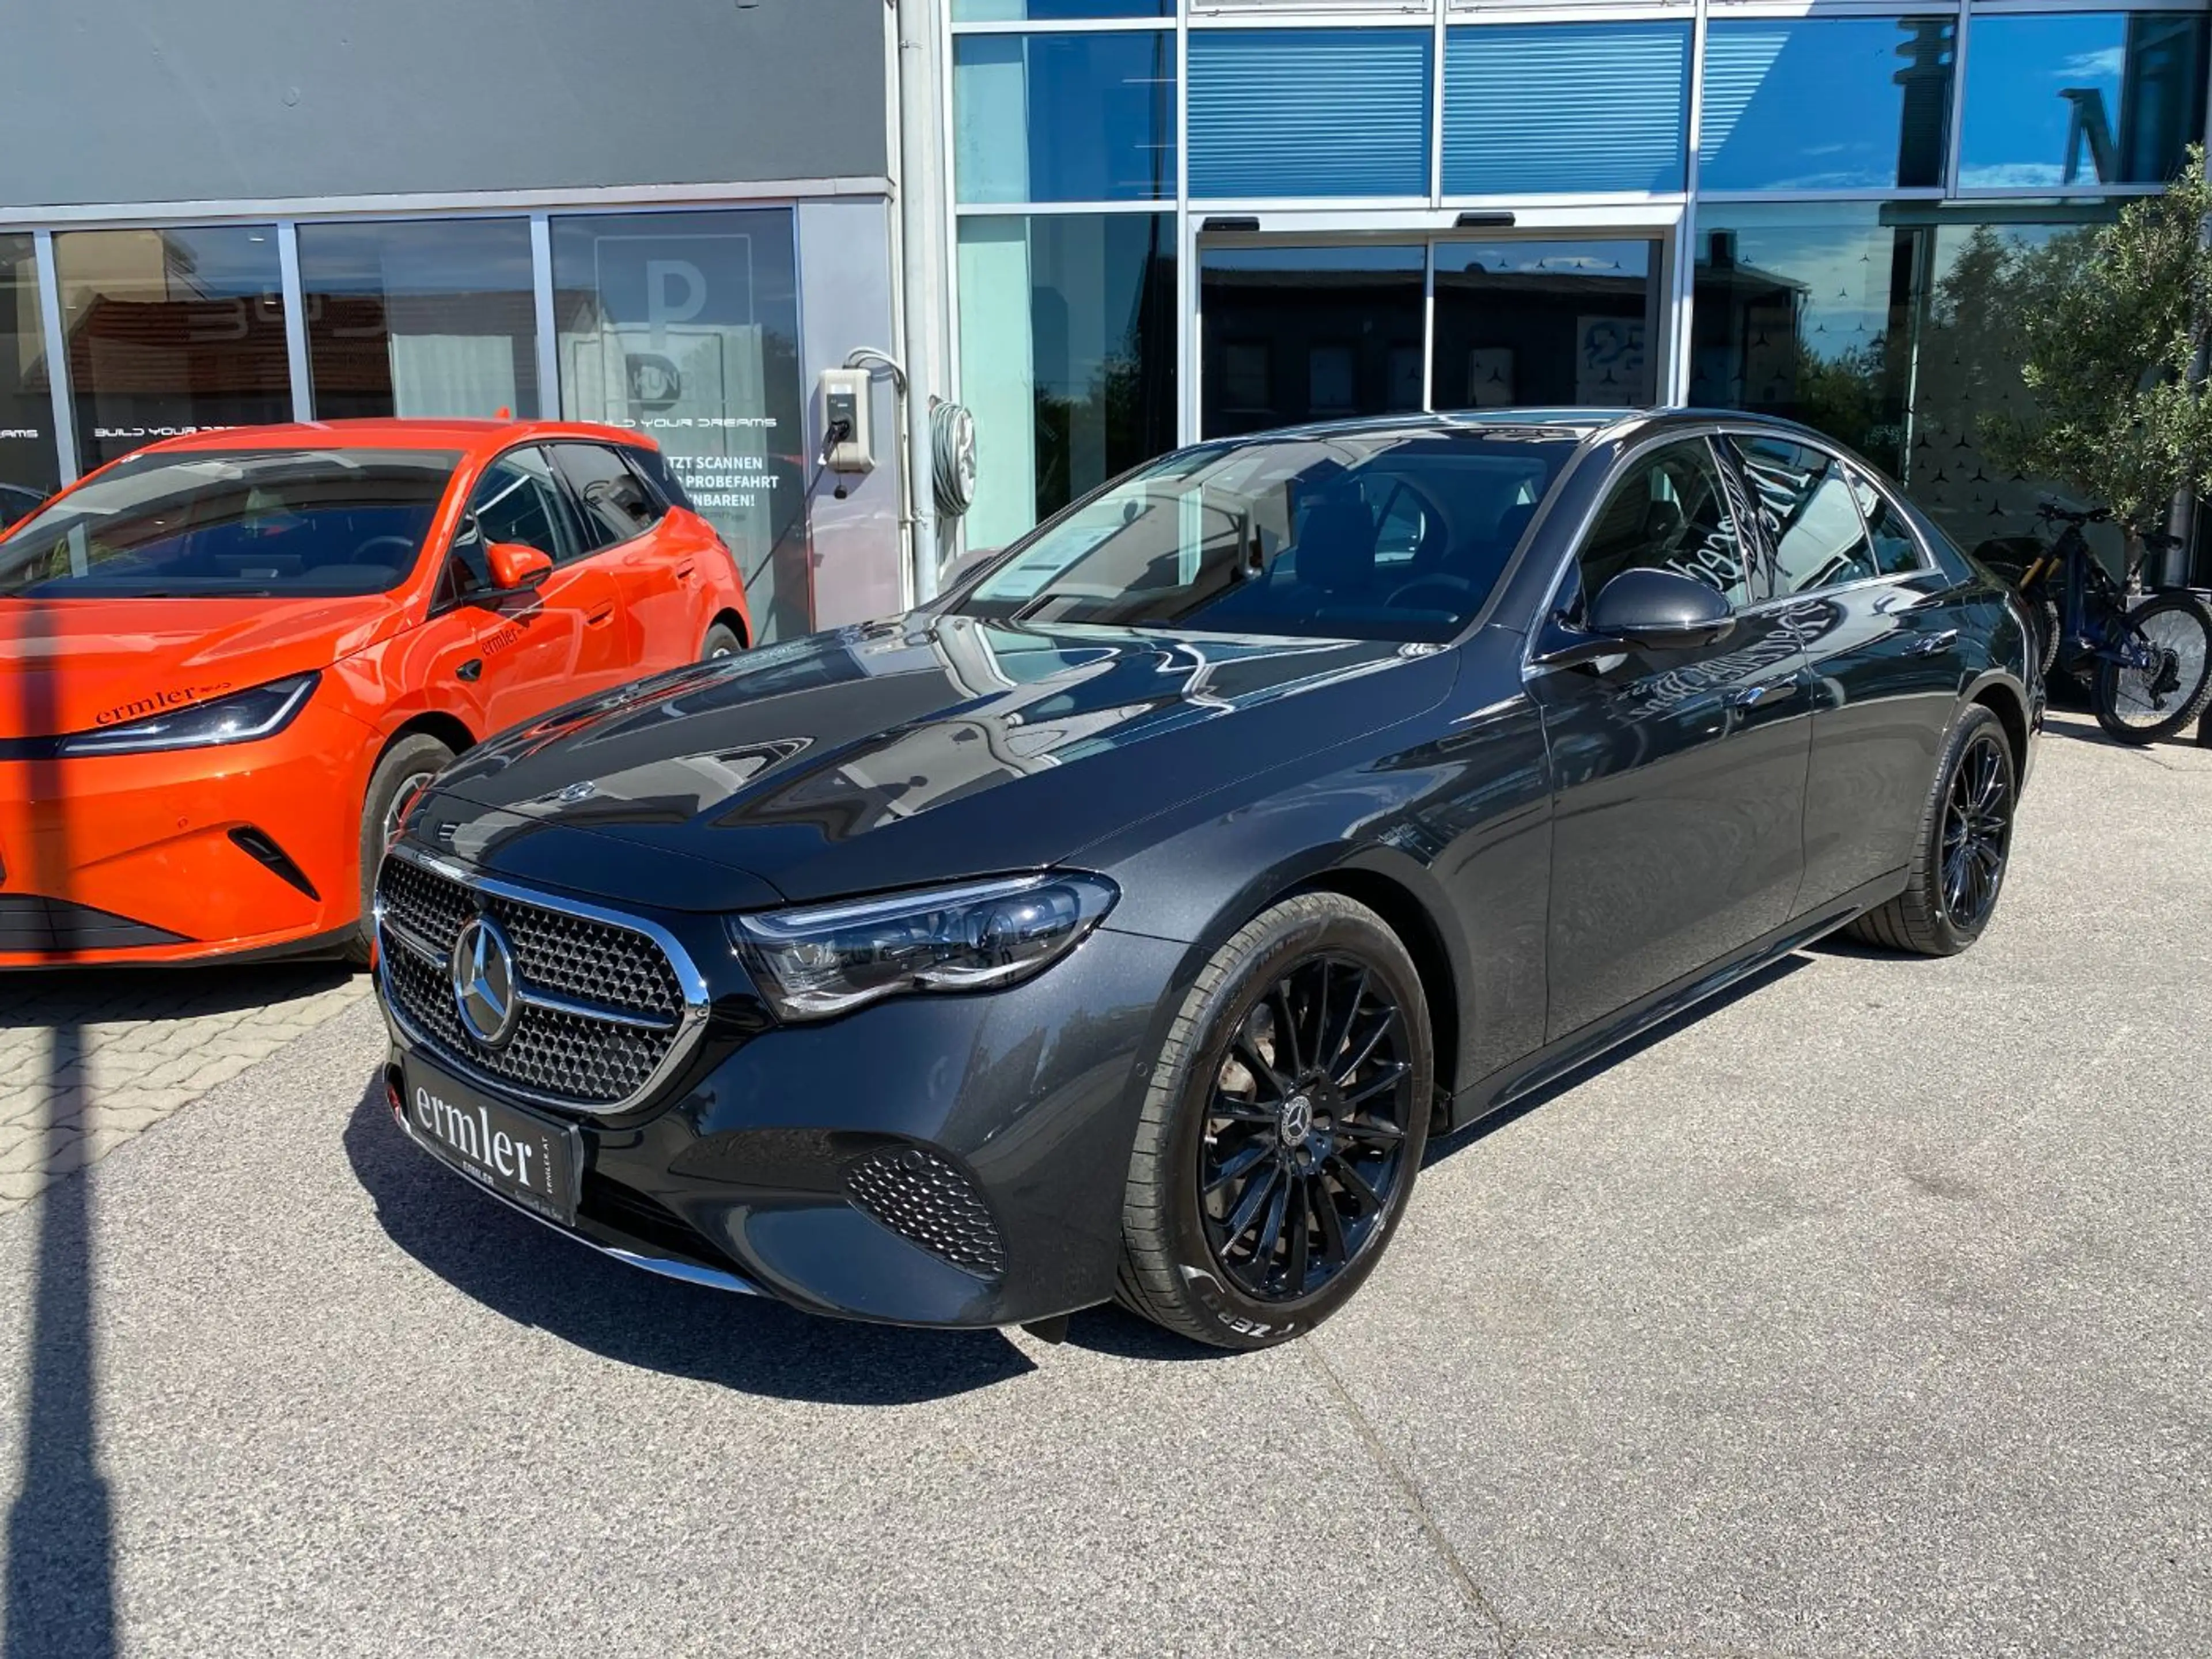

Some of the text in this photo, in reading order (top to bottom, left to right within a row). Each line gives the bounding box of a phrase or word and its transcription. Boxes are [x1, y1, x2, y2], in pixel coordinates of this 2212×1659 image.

[641, 418, 693, 428] YOUR
[698, 418, 778, 428] DREAMS
[94, 427, 145, 437] BUILD
[148, 426, 196, 437] YOUR
[666, 456, 763, 469] TZT SCANNEN
[685, 475, 780, 489] PROBEFAHRT
[689, 494, 755, 507] NBAREN!
[96, 687, 195, 725] ermler
[416, 1086, 532, 1187] ermler
